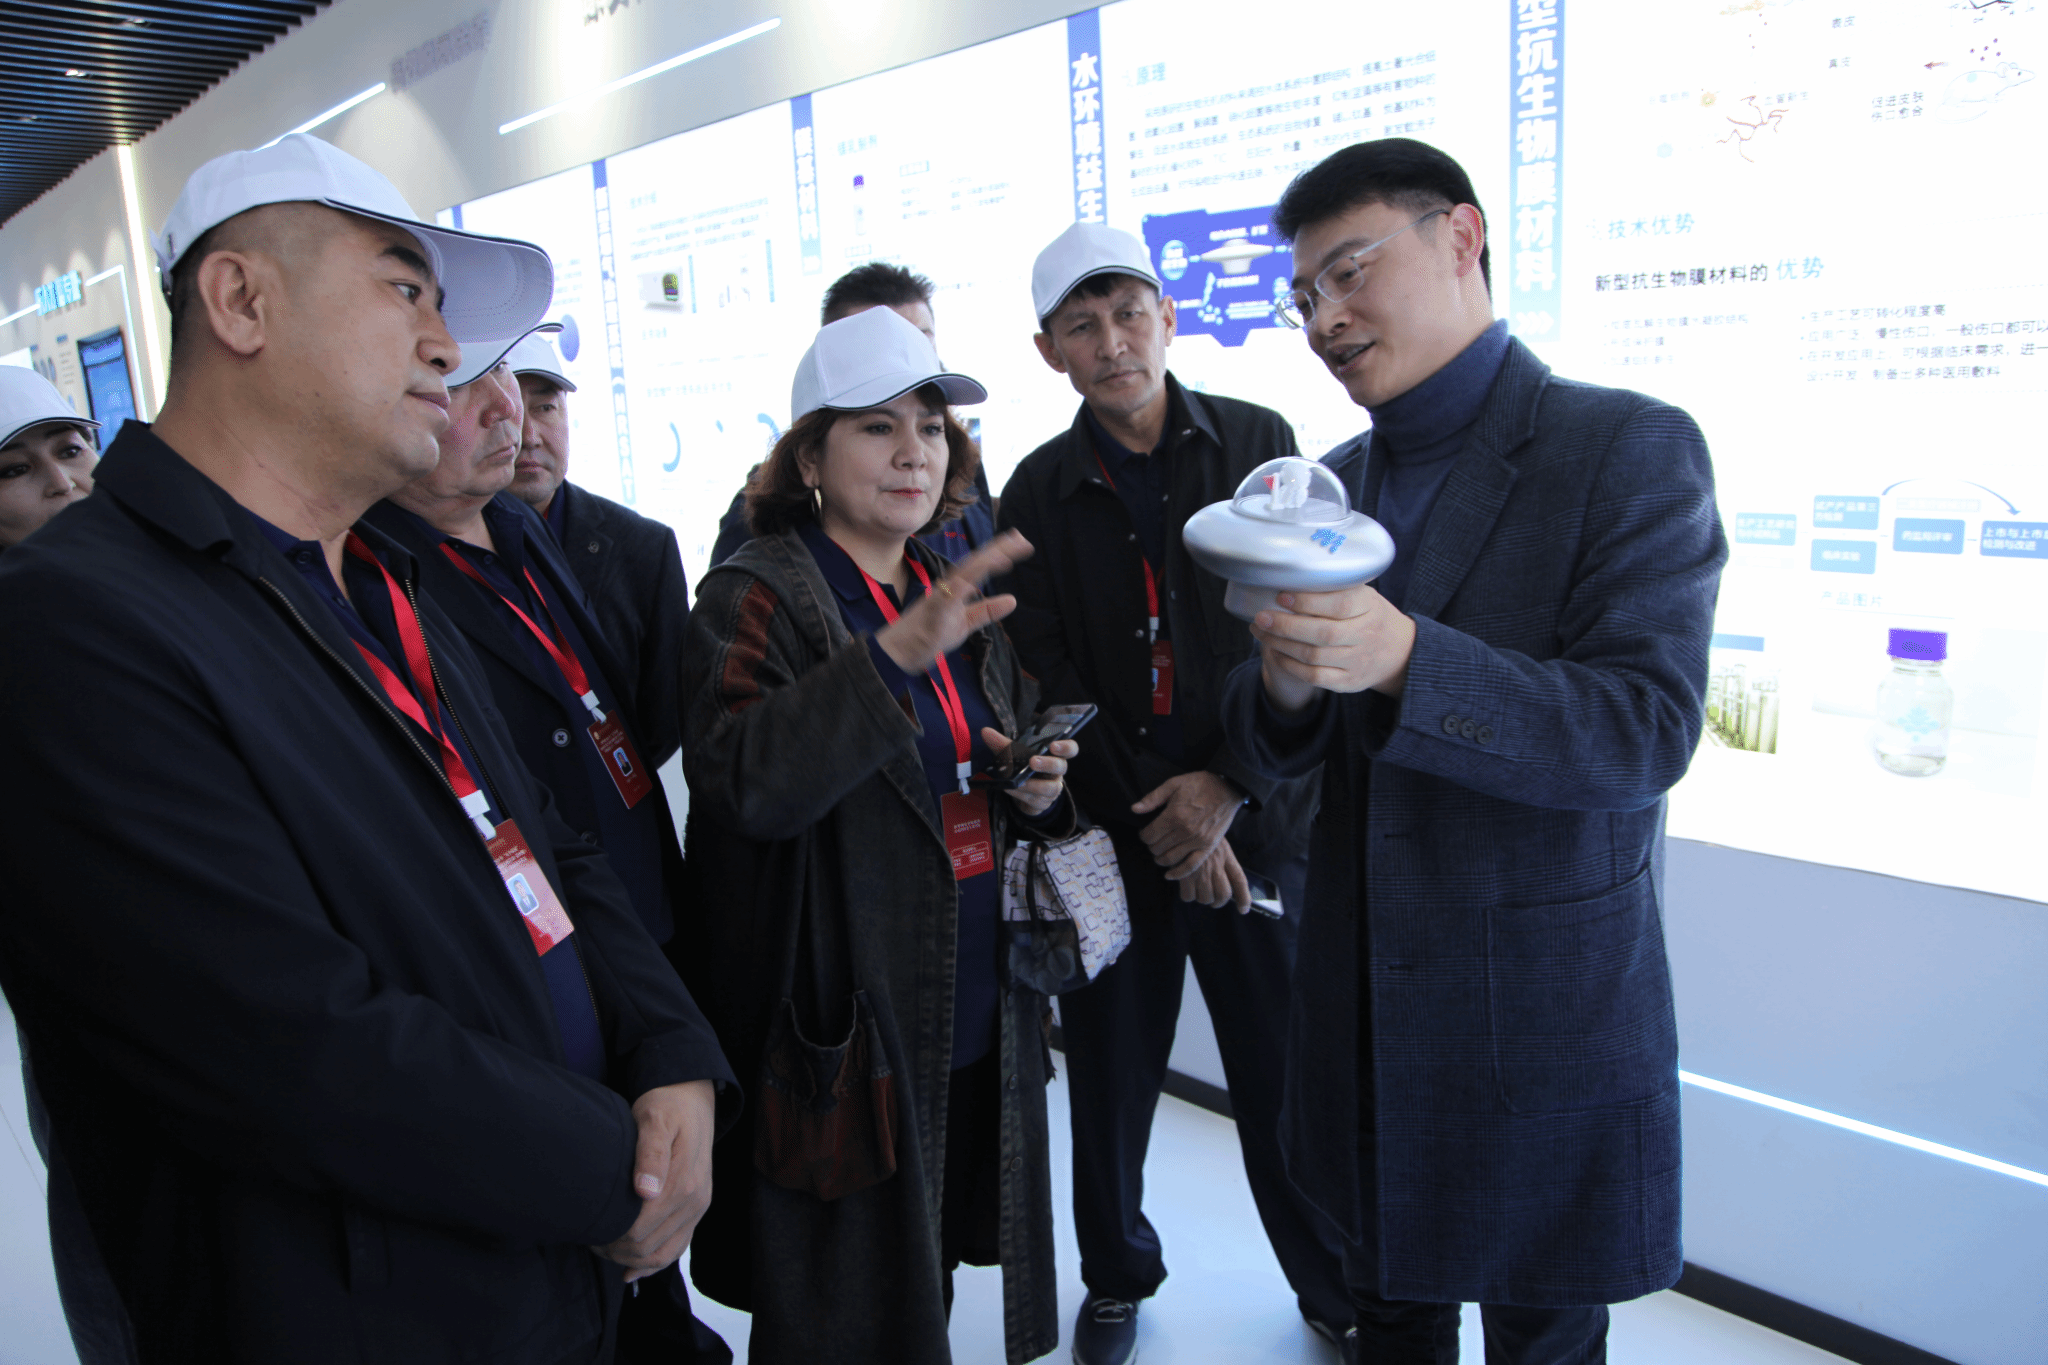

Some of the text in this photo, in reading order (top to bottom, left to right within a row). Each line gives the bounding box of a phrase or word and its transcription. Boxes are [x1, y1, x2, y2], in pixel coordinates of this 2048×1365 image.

[1608, 212, 1695, 240] 技术优势
[1596, 256, 1824, 291] 新型抗生物膜材料的 优势
[1820, 591, 1883, 608] 产品图片
